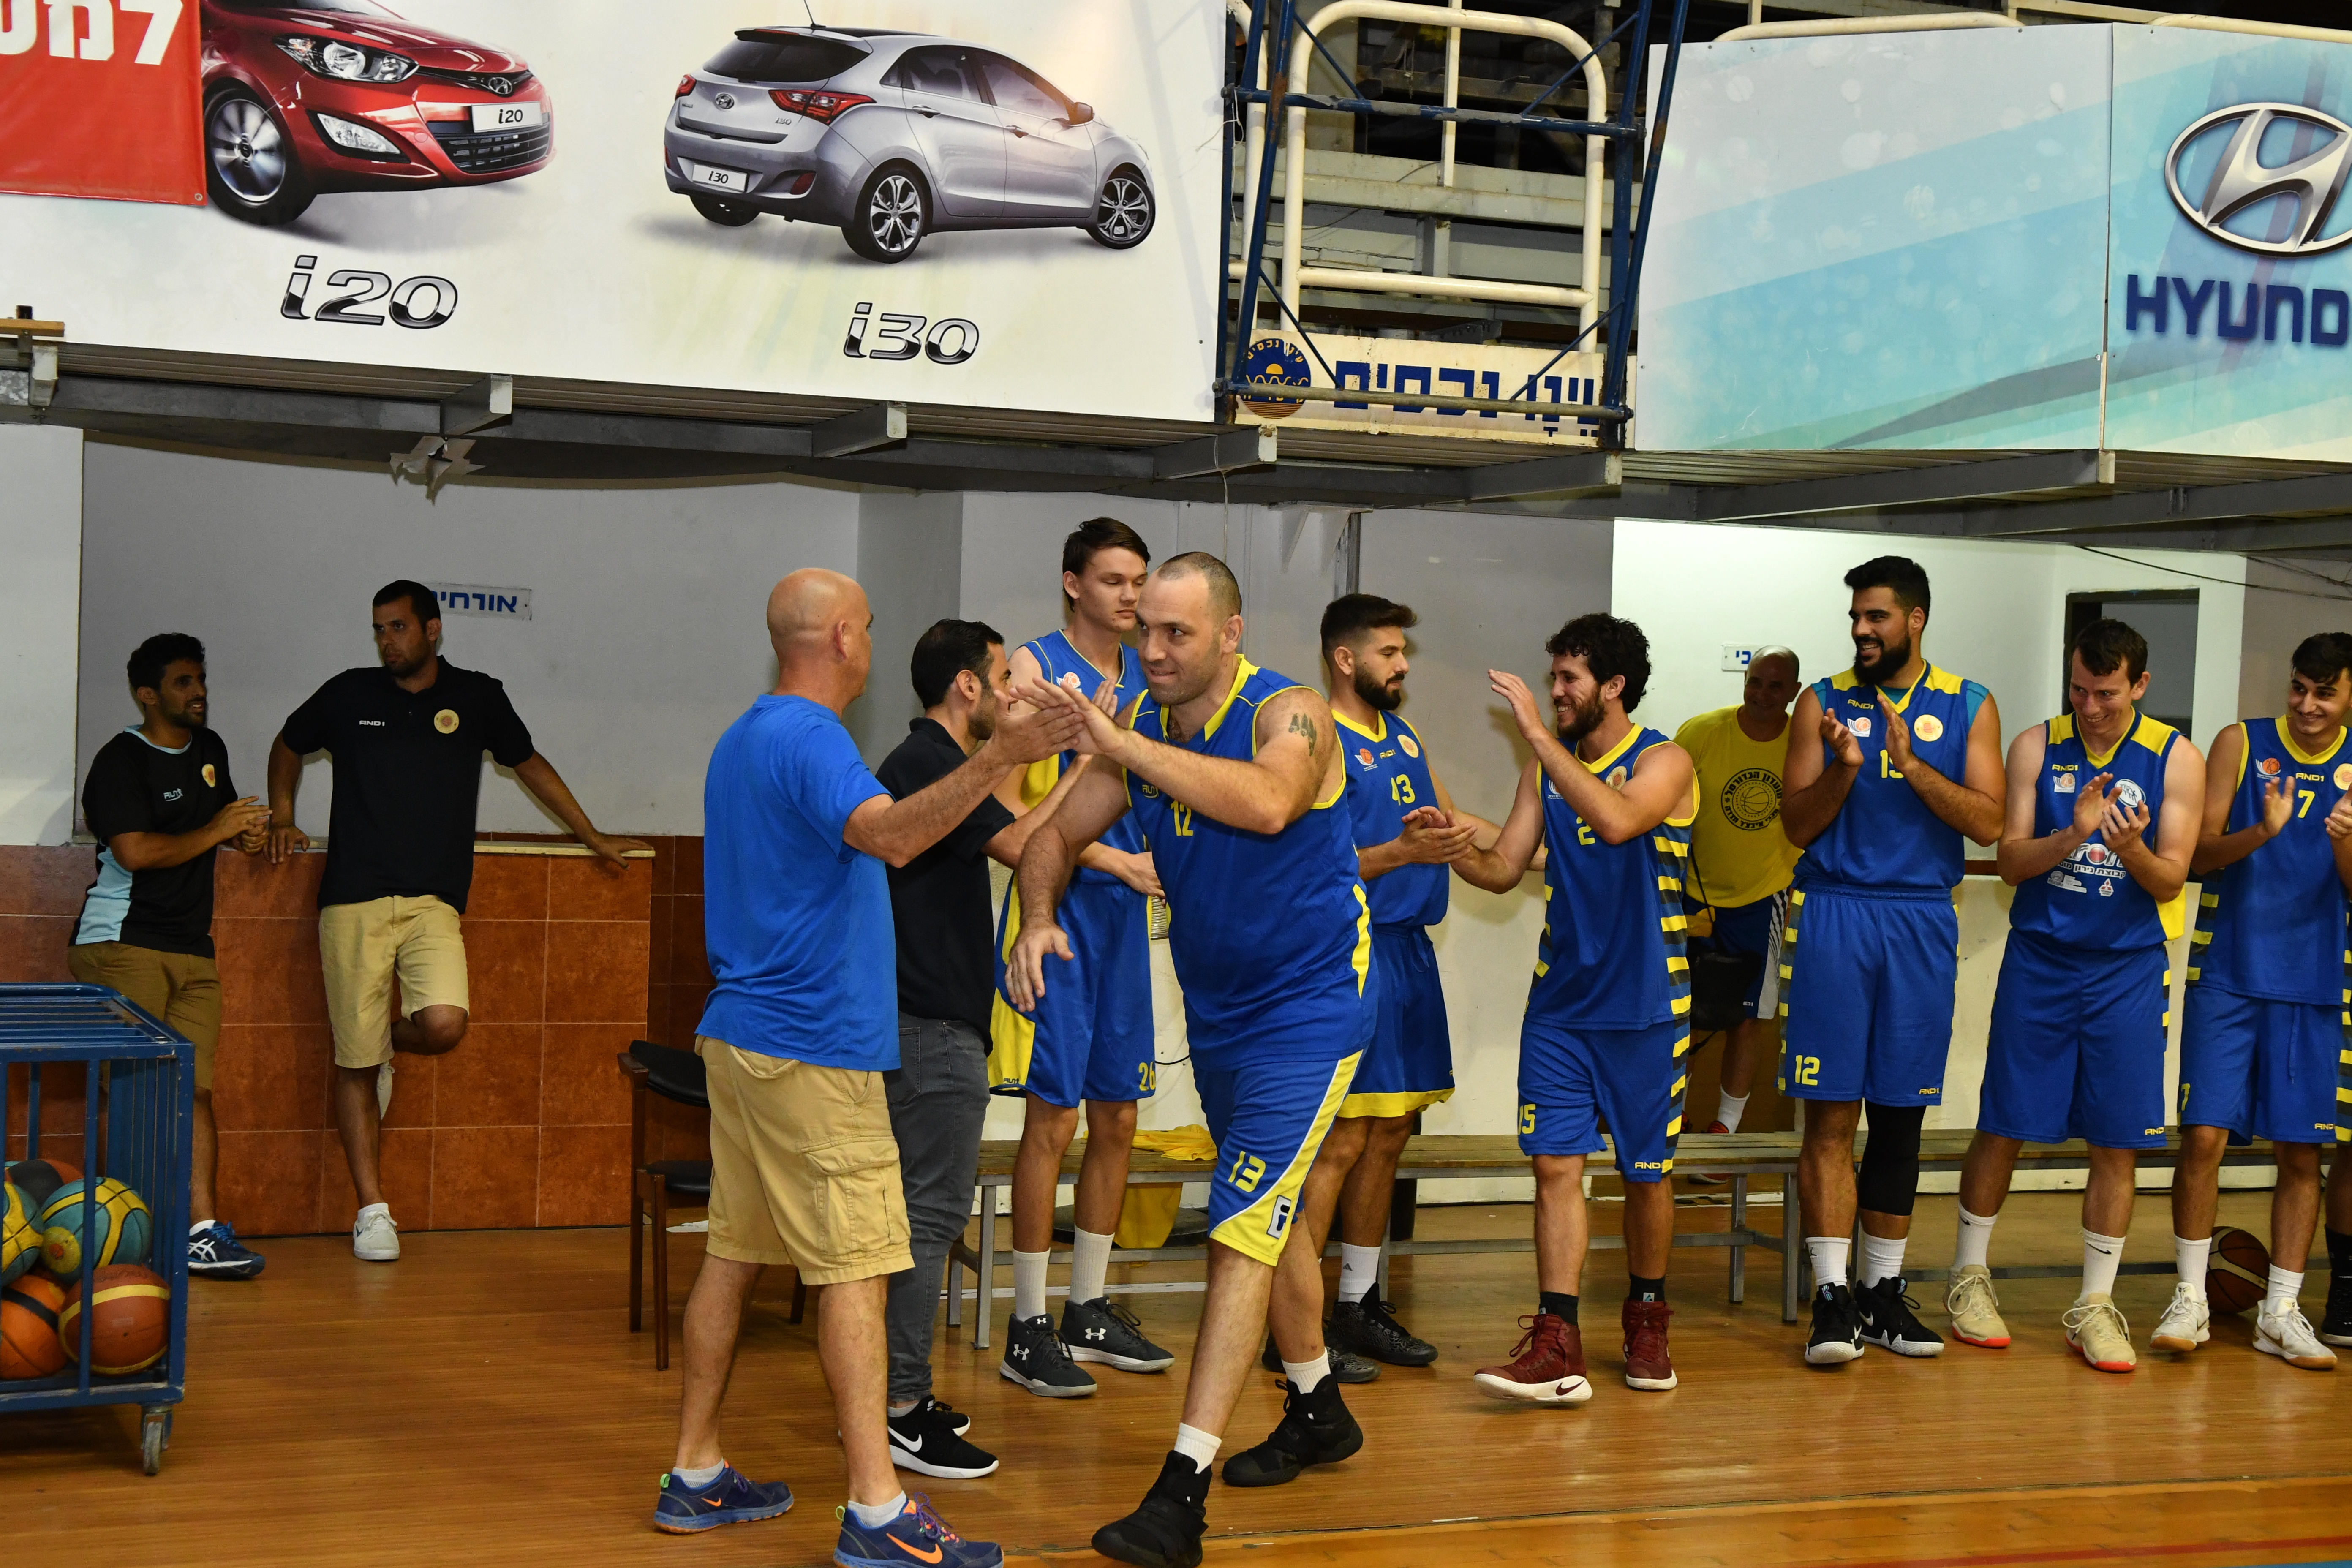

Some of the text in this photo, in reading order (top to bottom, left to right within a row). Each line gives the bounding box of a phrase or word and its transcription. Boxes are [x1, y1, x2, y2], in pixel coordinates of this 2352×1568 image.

[498, 109, 523, 124] i20
[708, 171, 729, 184] i30
[280, 255, 458, 329] i20
[2126, 274, 2349, 346] HYUND
[843, 302, 980, 365] i30
[1334, 361, 1499, 418] נכסים
[2295, 772, 2325, 782] AND1
[1171, 800, 1193, 836] 12
[2298, 789, 2315, 818] 7
[2097, 869, 2126, 878] קבוצת
[1138, 1062, 1155, 1091] 26
[1795, 1055, 1820, 1086] 12
[1228, 1150, 1266, 1192] 13
